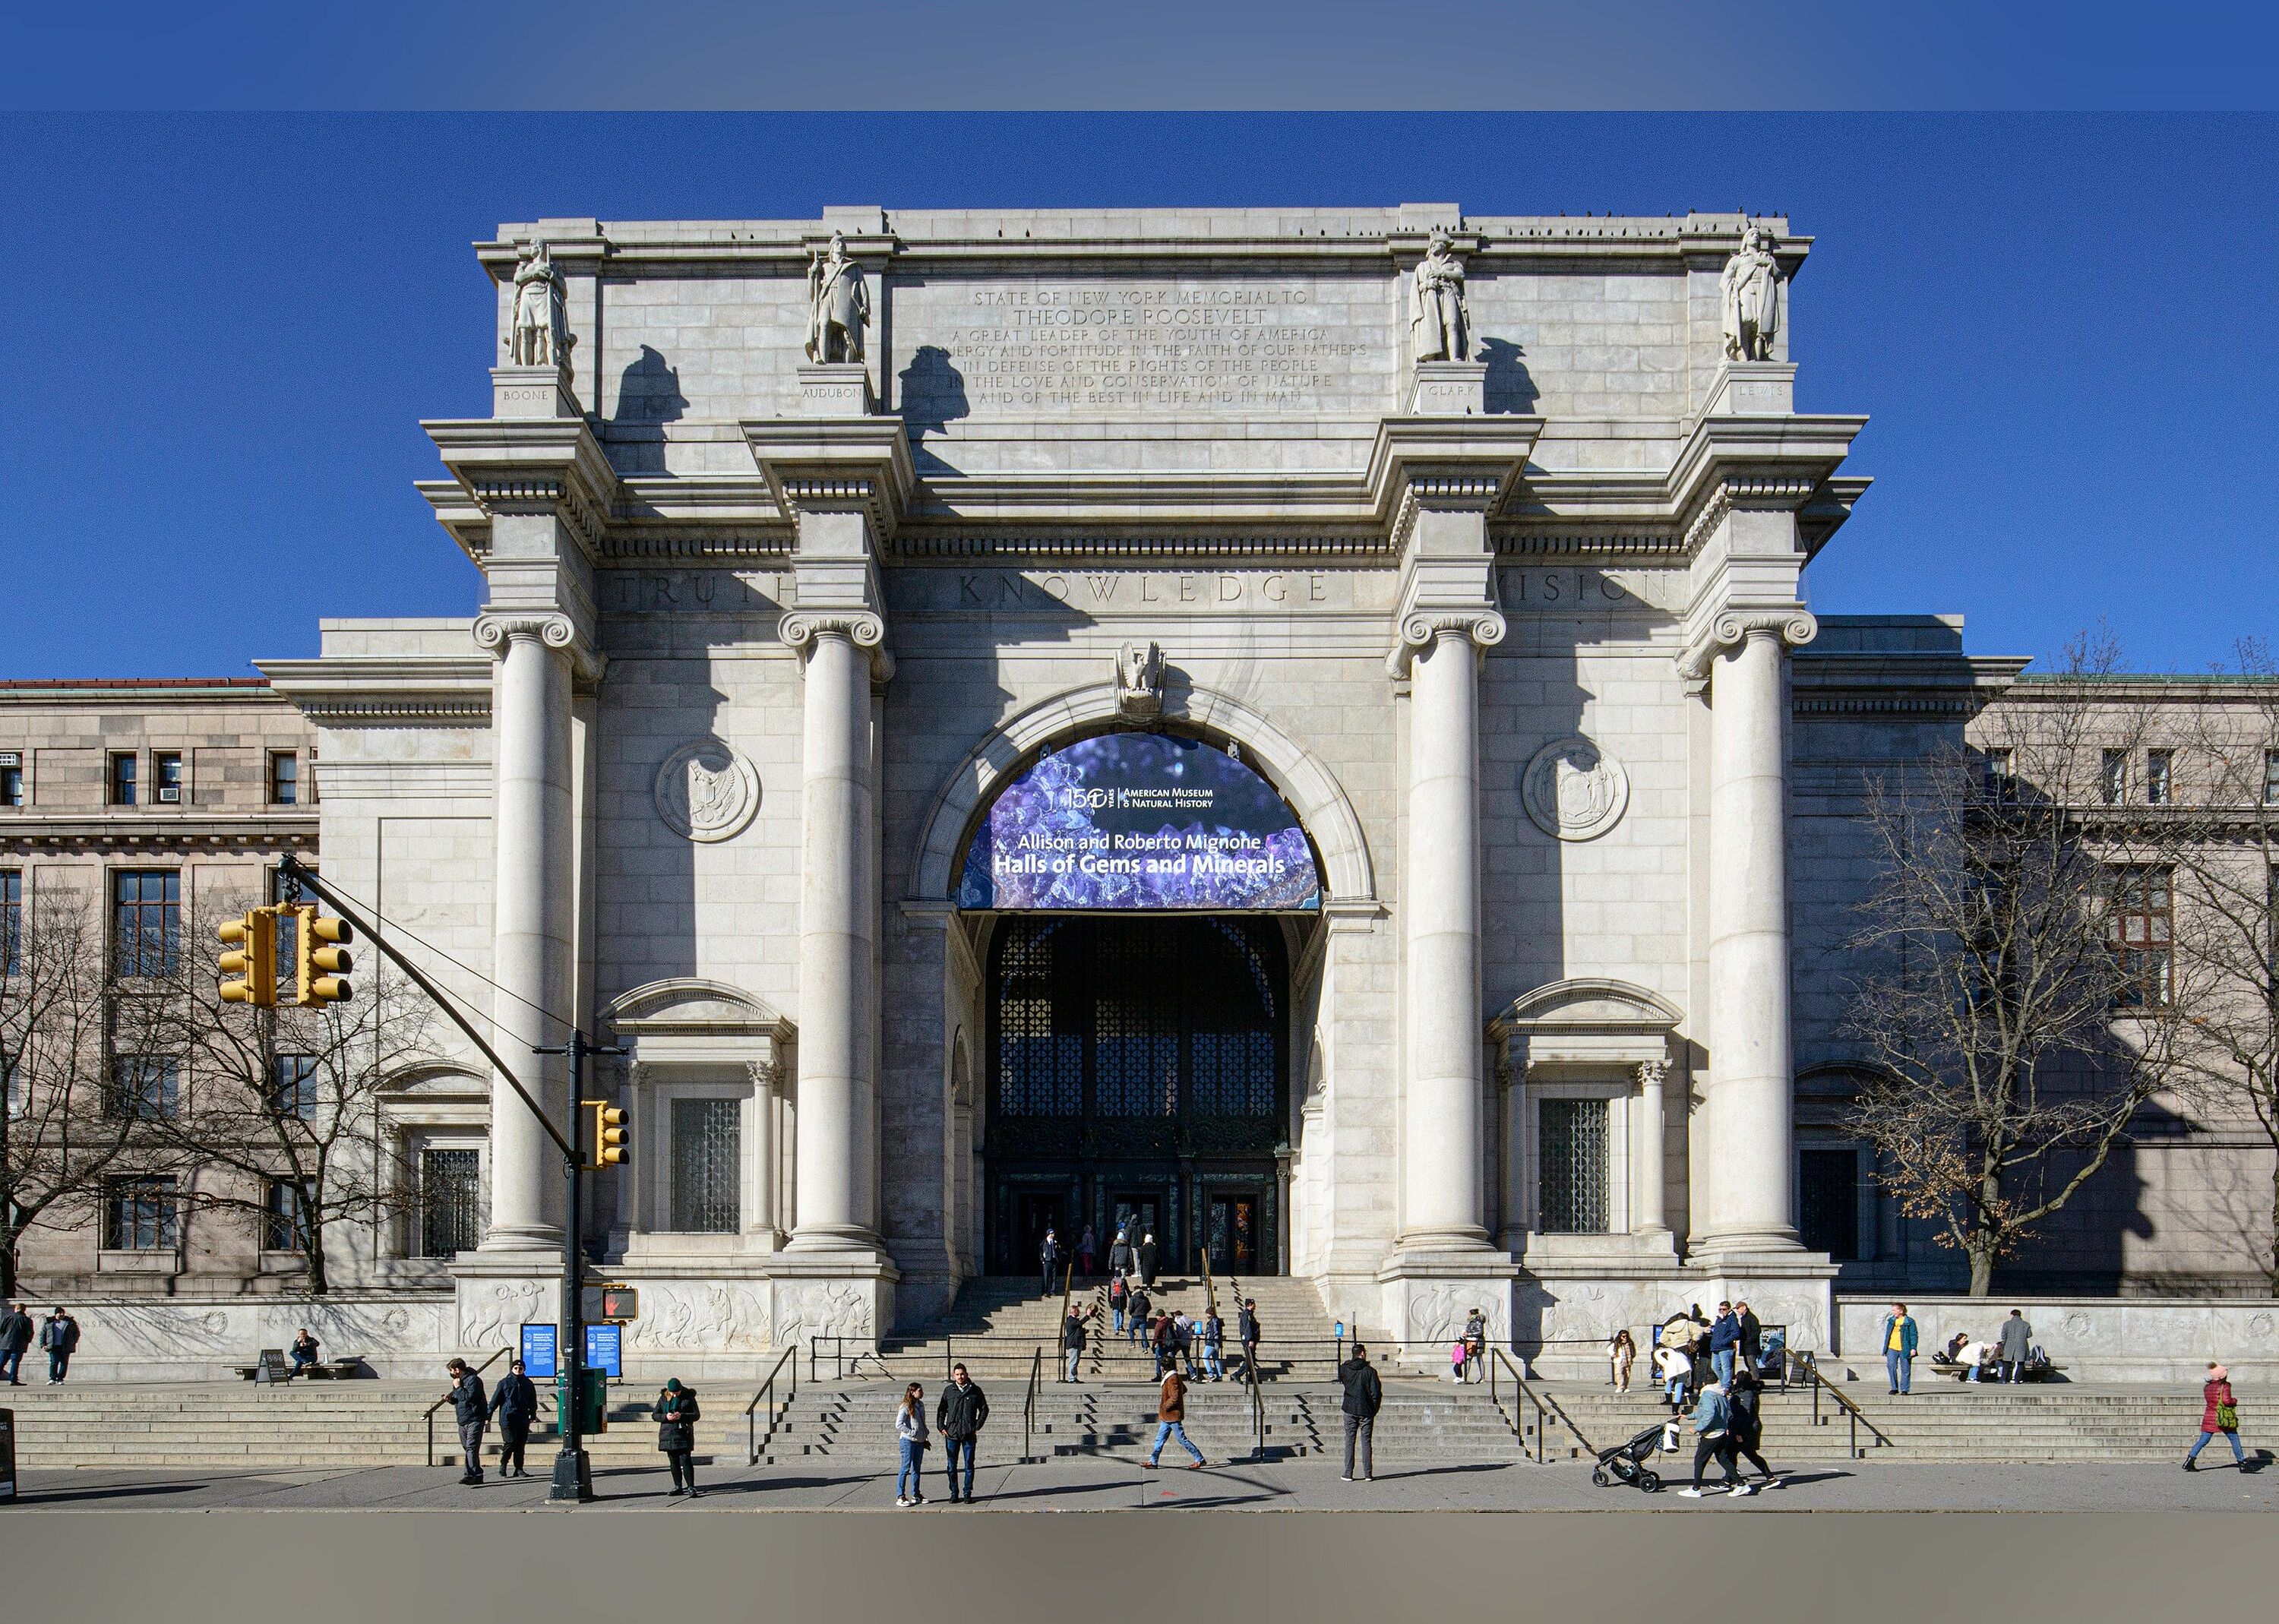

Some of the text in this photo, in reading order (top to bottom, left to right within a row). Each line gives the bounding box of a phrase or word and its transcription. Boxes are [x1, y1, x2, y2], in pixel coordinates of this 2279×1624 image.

[974, 291, 1307, 305] STATE OF NEW YORK MEMORIAL TO
[1013, 309, 1267, 325] THEODORE ROOSEVELT
[952, 329, 1329, 341] A GREAT LEADER OF THE YOUTH OF AMERICA
[938, 346, 994, 357] ENERGY
[1000, 346, 1032, 357] AND
[1040, 346, 1124, 356] FORTITUDE
[1132, 346, 1146, 356] IN
[1155, 346, 1181, 356] THE
[1188, 346, 1231, 356] FAITH
[1238, 346, 1256, 356] OF
[1264, 346, 1295, 356] OUR
[1304, 344, 1367, 355] FATHERS
[963, 361, 1318, 371] IN DEFENSE OF THE RIGHTS OF THE PEOPLE
[973, 376, 1003, 387] THE
[1013, 376, 1052, 387] LOVE
[1060, 376, 1094, 387] AND
[1102, 376, 1228, 387] CONSERVATION
[1237, 376, 1256, 387] OF
[1267, 376, 1332, 387] NATURE
[504, 391, 548, 400] BOONE
[802, 388, 861, 397] AUDUBON
[1429, 386, 1475, 395] CLARK
[1739, 386, 1783, 396] LEWIS
[979, 392, 1301, 403] AND OF THE BEST IN LIFE AND IN MAN
[615, 577, 798, 602] TRUTH
[958, 574, 1329, 603] KNOWLEDGE
[1123, 788, 1213, 797] AMERICAN MUSEUM
[1132, 799, 1173, 808] NATURAL
[1175, 799, 1213, 808] HISTORY
[1018, 835, 1261, 855] Allison and Roberto Mignone
[996, 855, 1285, 874] Halls of Gems and Minerals
